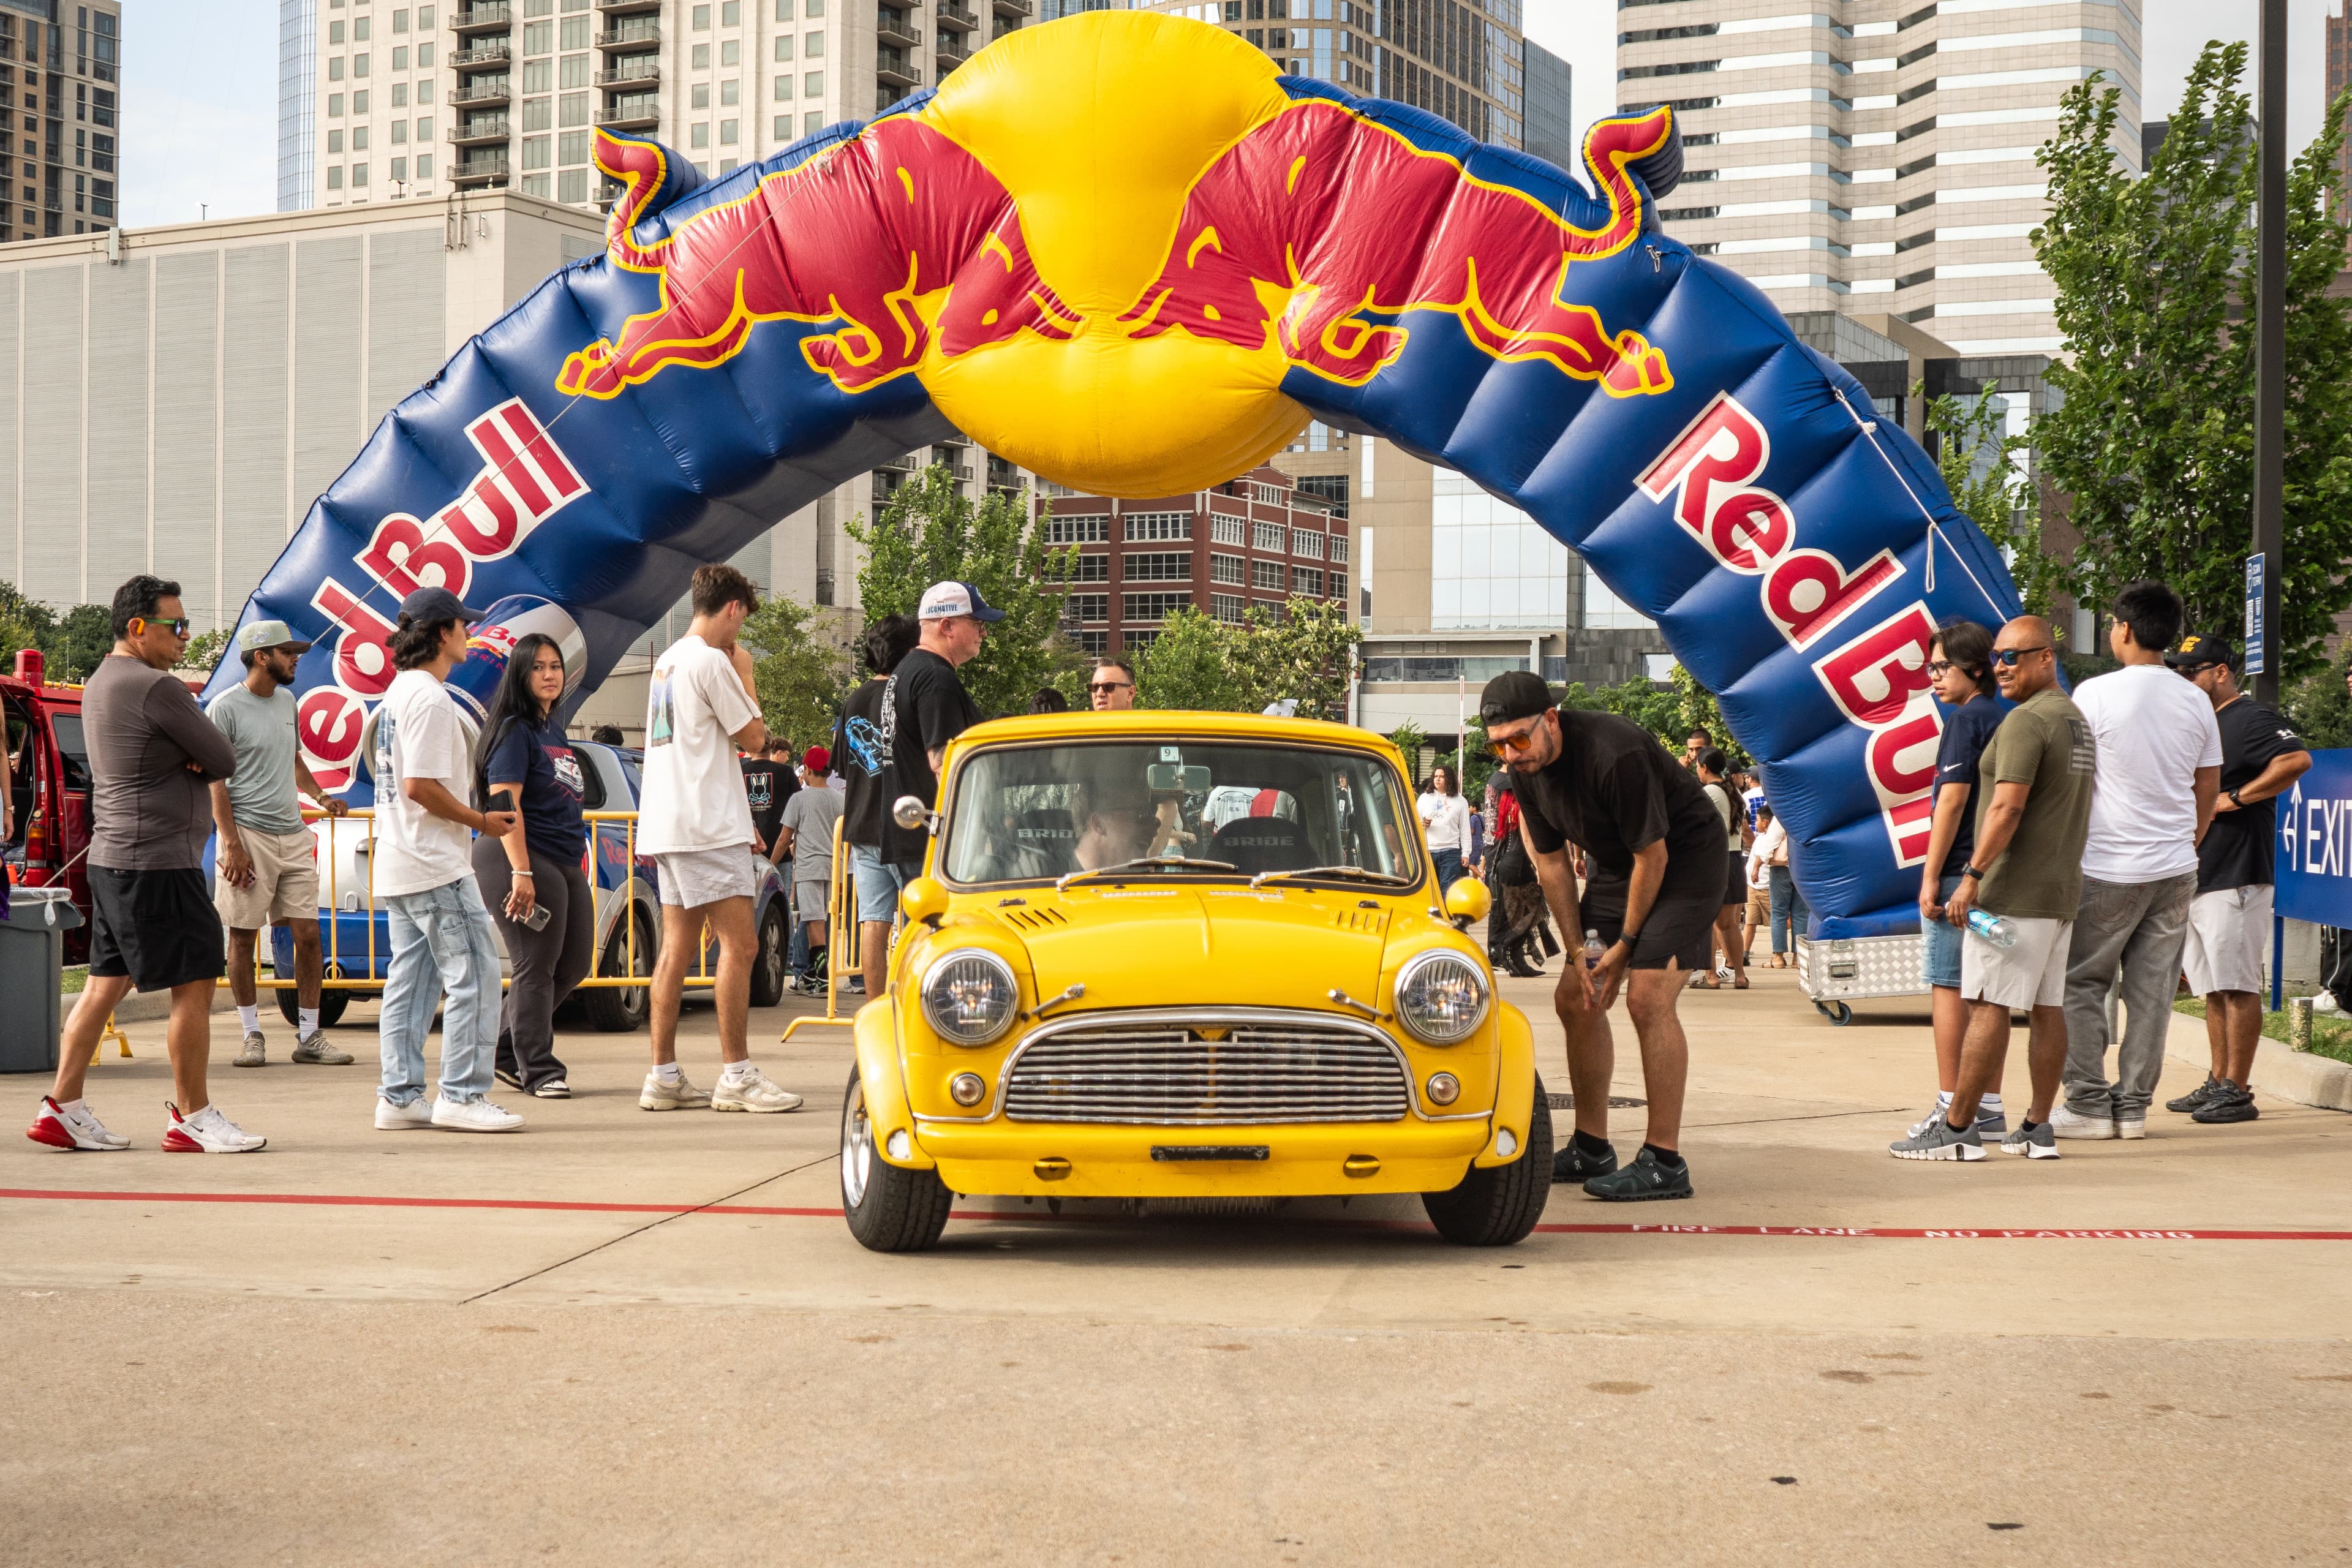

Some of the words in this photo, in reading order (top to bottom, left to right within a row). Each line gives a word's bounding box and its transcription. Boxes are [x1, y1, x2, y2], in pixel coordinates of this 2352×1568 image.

[360, 401, 583, 603] Bull
[925, 604, 959, 614] LOCOMOTIVE
[1643, 399, 1898, 645] Red
[1822, 608, 1940, 861] Bu
[466, 651, 505, 672] DRIN
[443, 682, 466, 696] Body
[467, 696, 483, 710] and
[1017, 829, 1079, 838] BRID
[1224, 836, 1294, 846] BRIDE
[1633, 1224, 1728, 1233] FIRE
[1760, 1226, 1875, 1235] LANE
[2002, 1230, 2195, 1239] PARKING
